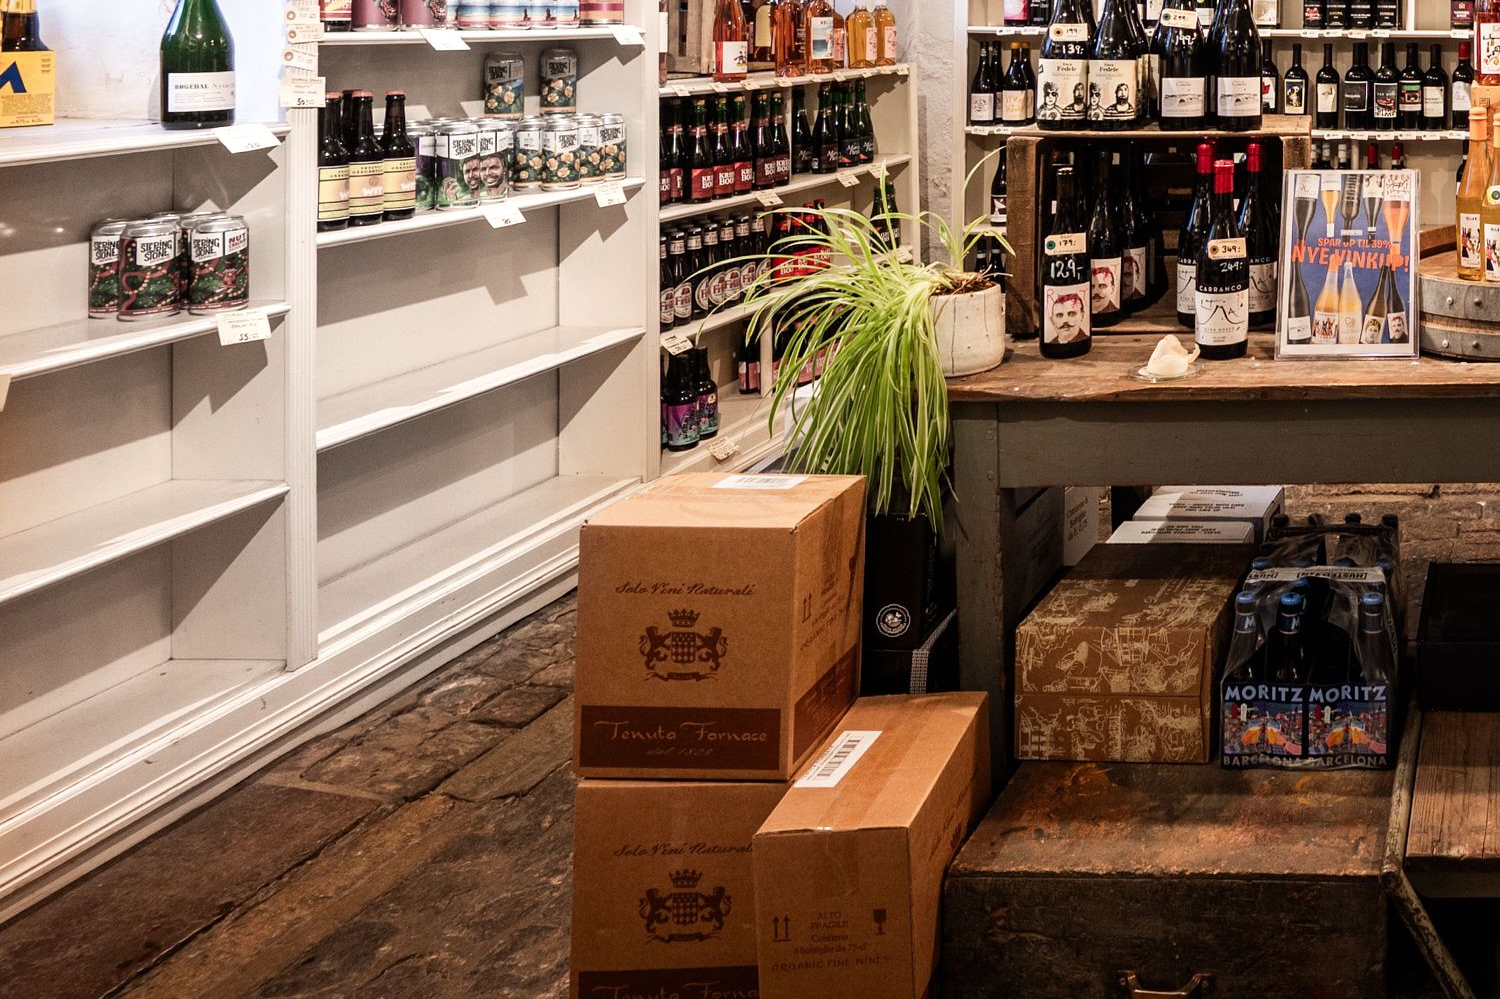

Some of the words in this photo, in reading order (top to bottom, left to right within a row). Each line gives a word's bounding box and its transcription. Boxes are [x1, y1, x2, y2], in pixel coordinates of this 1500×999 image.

[228, 234, 247, 243] NUT
[1318, 237, 1342, 247] SPAR
[1357, 239, 1370, 249] TIL
[1199, 284, 1242, 292] CARRANCO
[616, 582, 648, 594] Solo
[651, 582, 686, 595] Vini
[687, 583, 755, 596] Naturali
[1224, 684, 1303, 702] MORITZ
[1309, 684, 1387, 703] MORITZ
[594, 721, 677, 741] Tenuta
[680, 721, 768, 742] Fornace
[615, 844, 648, 857] Solo
[650, 842, 686, 856] Vini
[686, 842, 752, 855] Natural
[816, 911, 842, 920] ALTO
